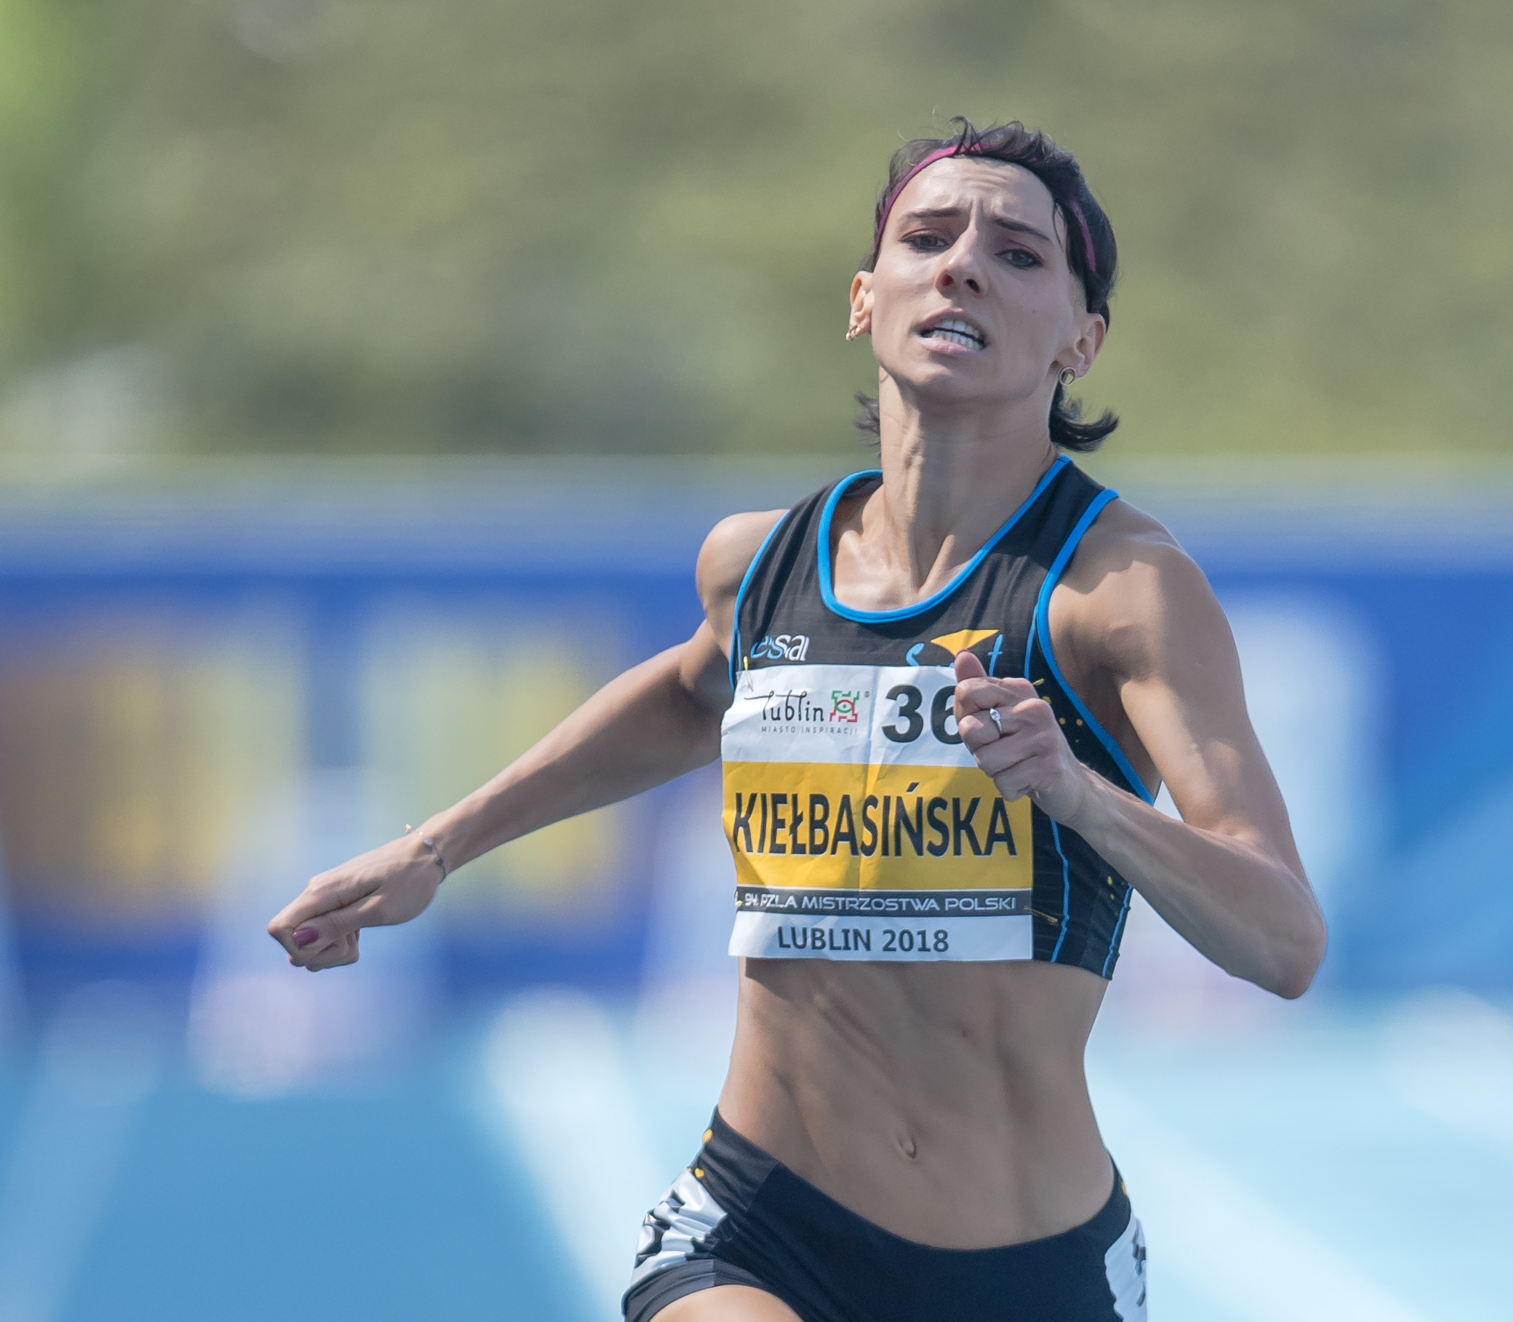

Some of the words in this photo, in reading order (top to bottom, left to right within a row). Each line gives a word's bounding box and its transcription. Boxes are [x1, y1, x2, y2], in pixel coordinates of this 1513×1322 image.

[761, 725, 796, 734] MIASTO
[801, 726, 858, 736] INSPIRACJI
[733, 782, 1017, 858] KIEŁBASIŃSKA
[760, 893, 798, 909] PZLA
[801, 896, 939, 911] MISTRZOSTWA
[945, 897, 1016, 911] POLSKI
[778, 926, 871, 952] LUBLIN
[882, 929, 950, 953] 2018
